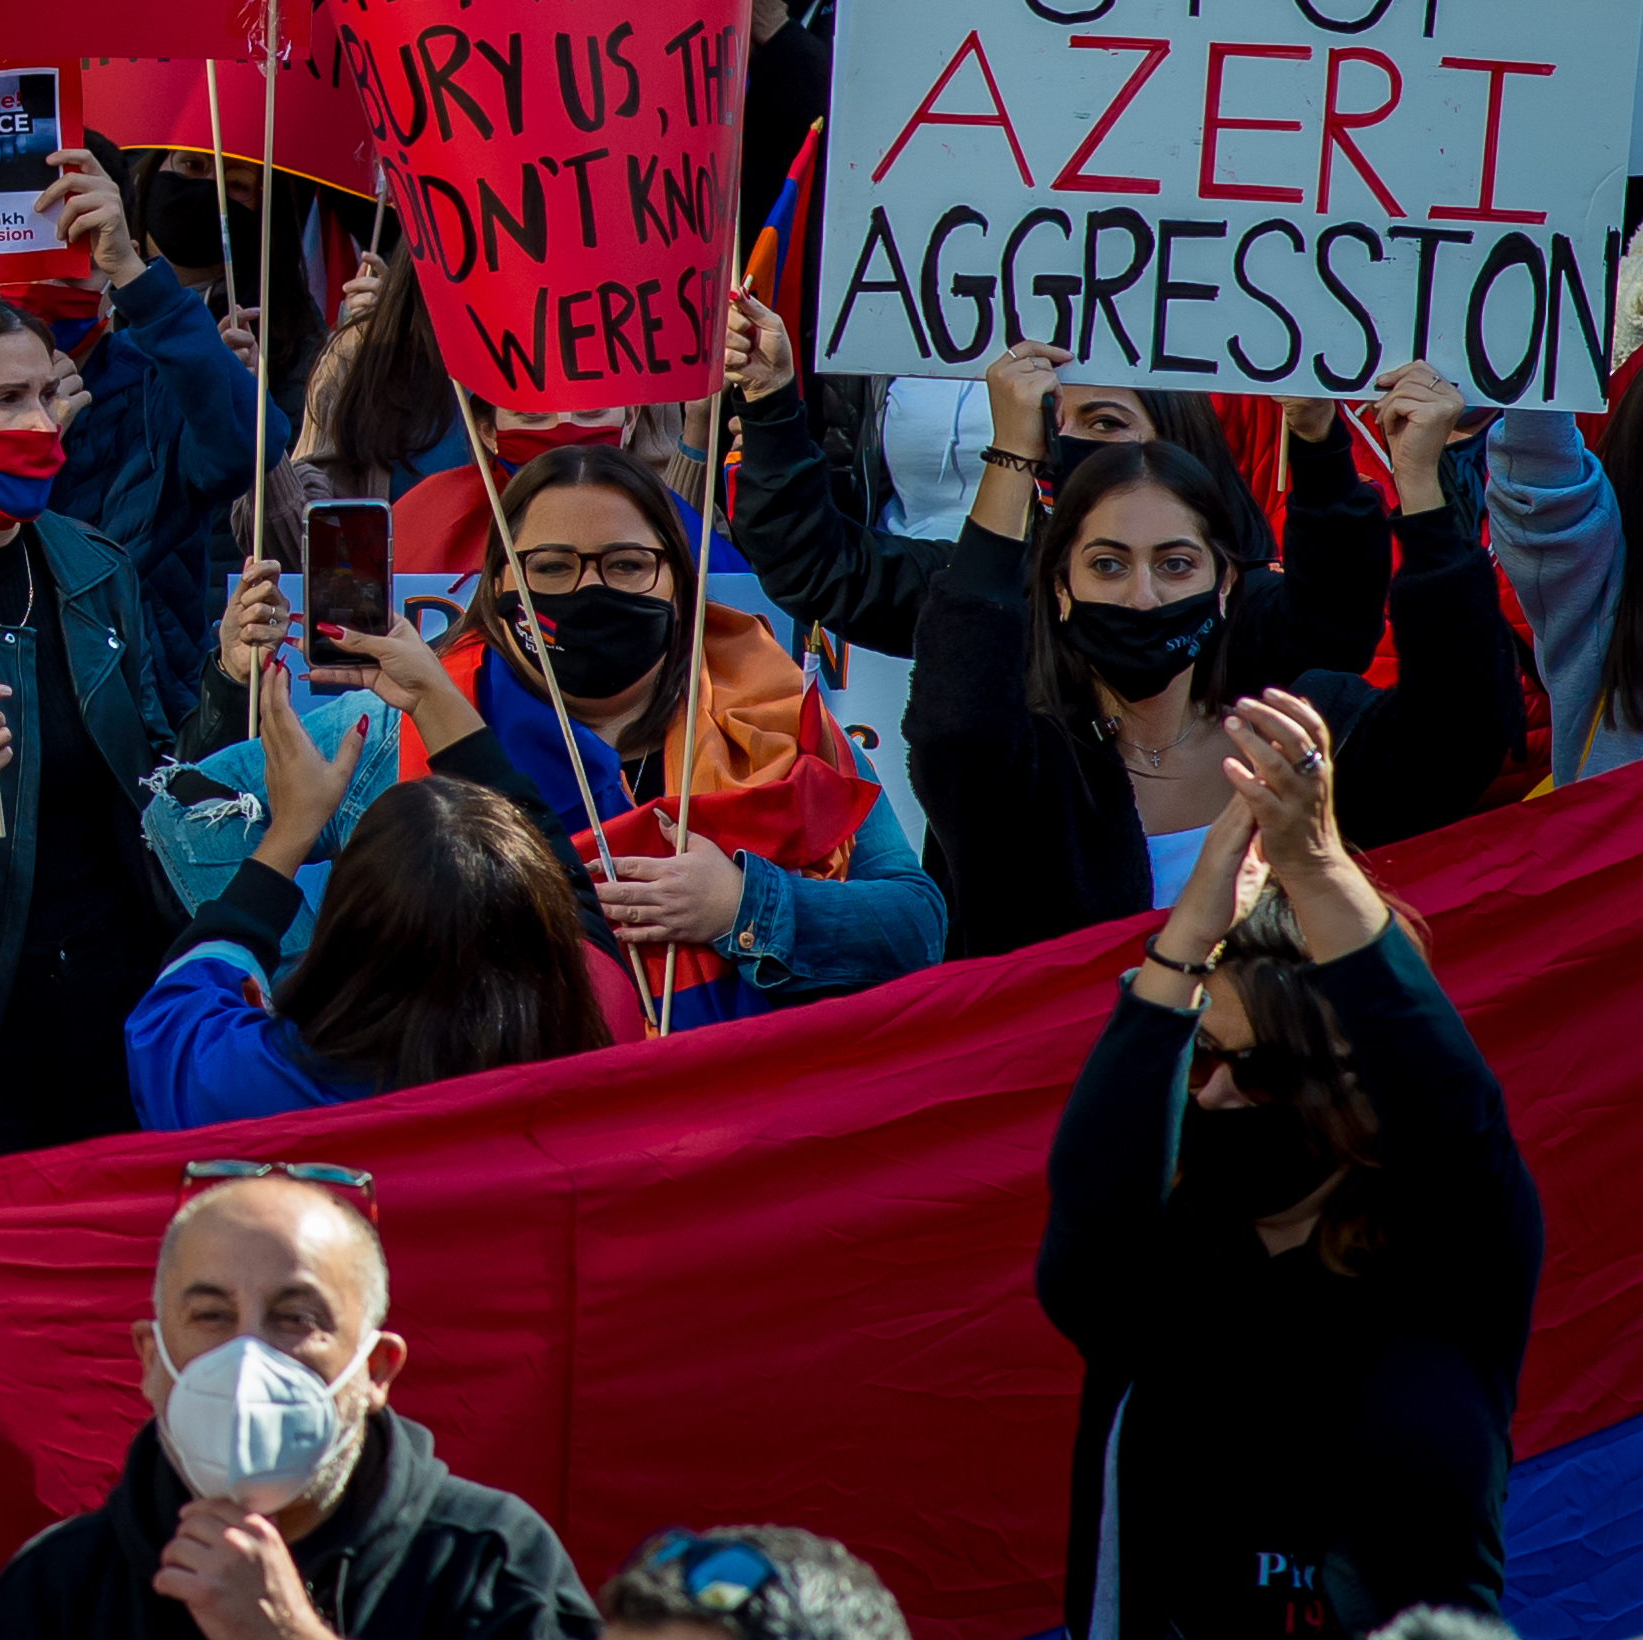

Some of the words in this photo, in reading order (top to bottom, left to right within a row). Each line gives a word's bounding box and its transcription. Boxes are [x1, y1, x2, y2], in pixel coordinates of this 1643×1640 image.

[340, 22, 524, 148] BURY
[870, 29, 1557, 225] AZERI
[465, 279, 672, 393] WERE
